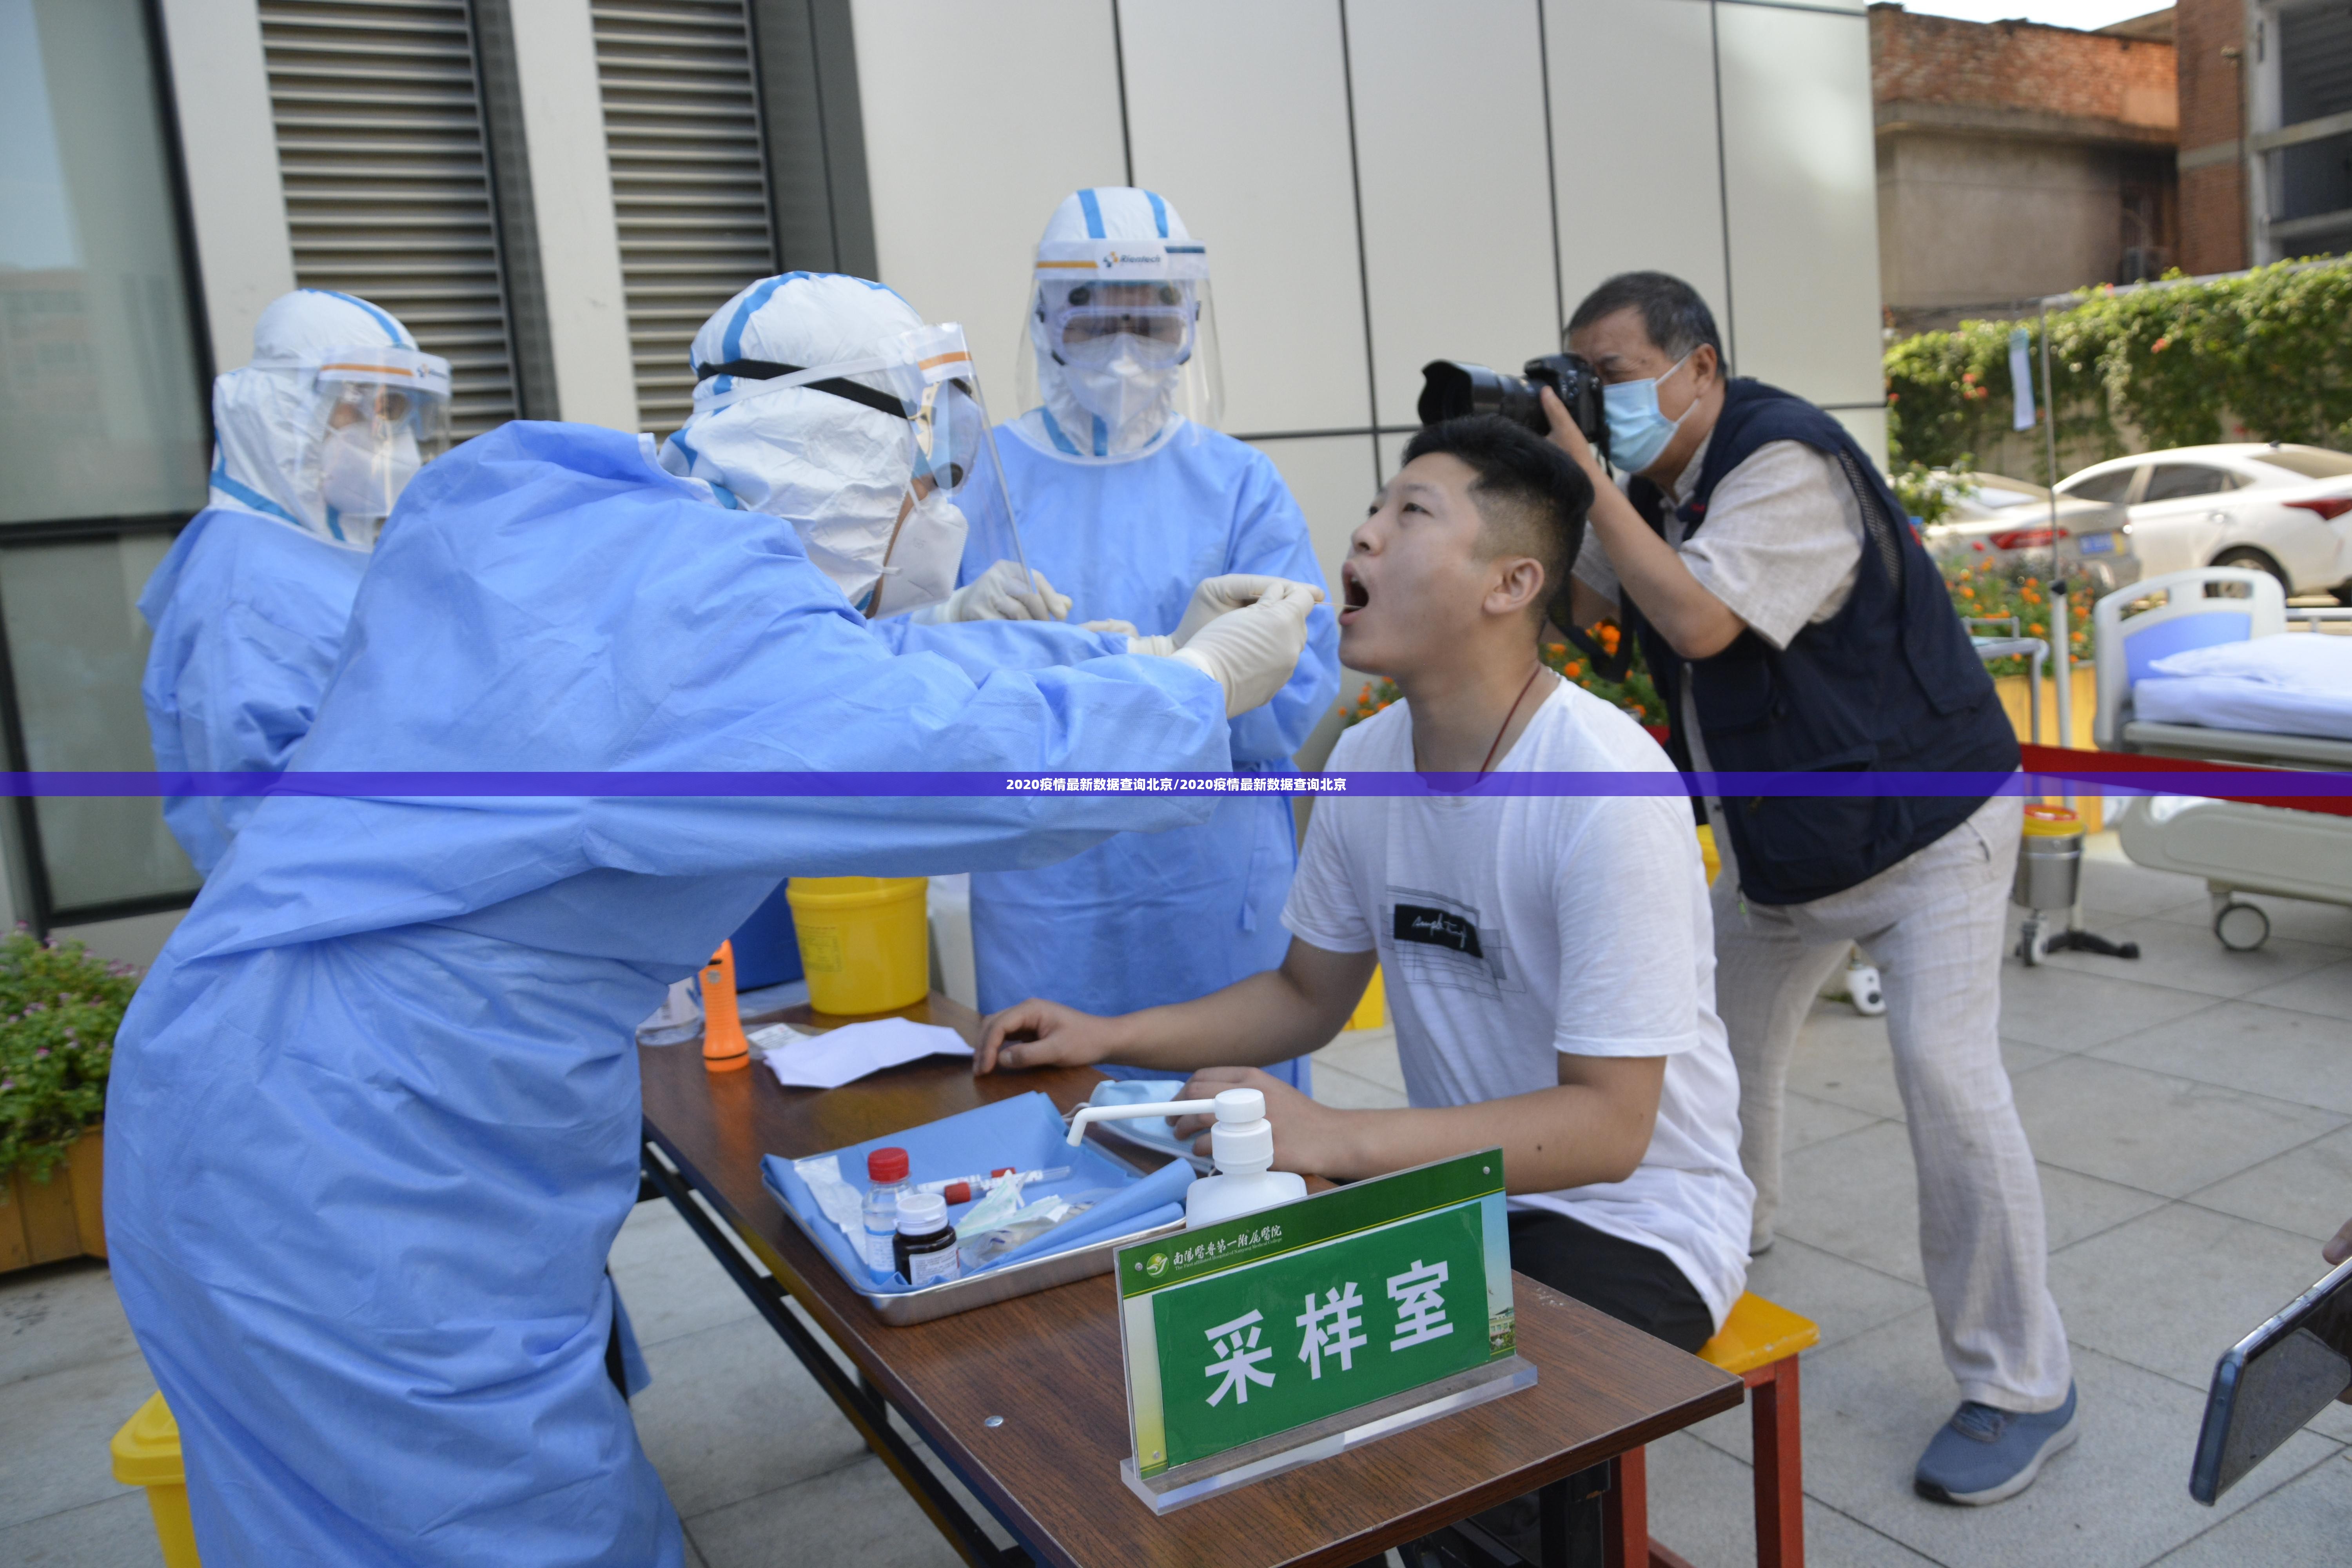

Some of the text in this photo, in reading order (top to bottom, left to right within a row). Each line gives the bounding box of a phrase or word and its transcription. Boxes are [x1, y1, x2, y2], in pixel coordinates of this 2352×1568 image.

[1212, 1252, 1229, 1261] Hospital
[1234, 1246, 1252, 1254] Nanyang
[1204, 1259, 1454, 1407] 采样室
